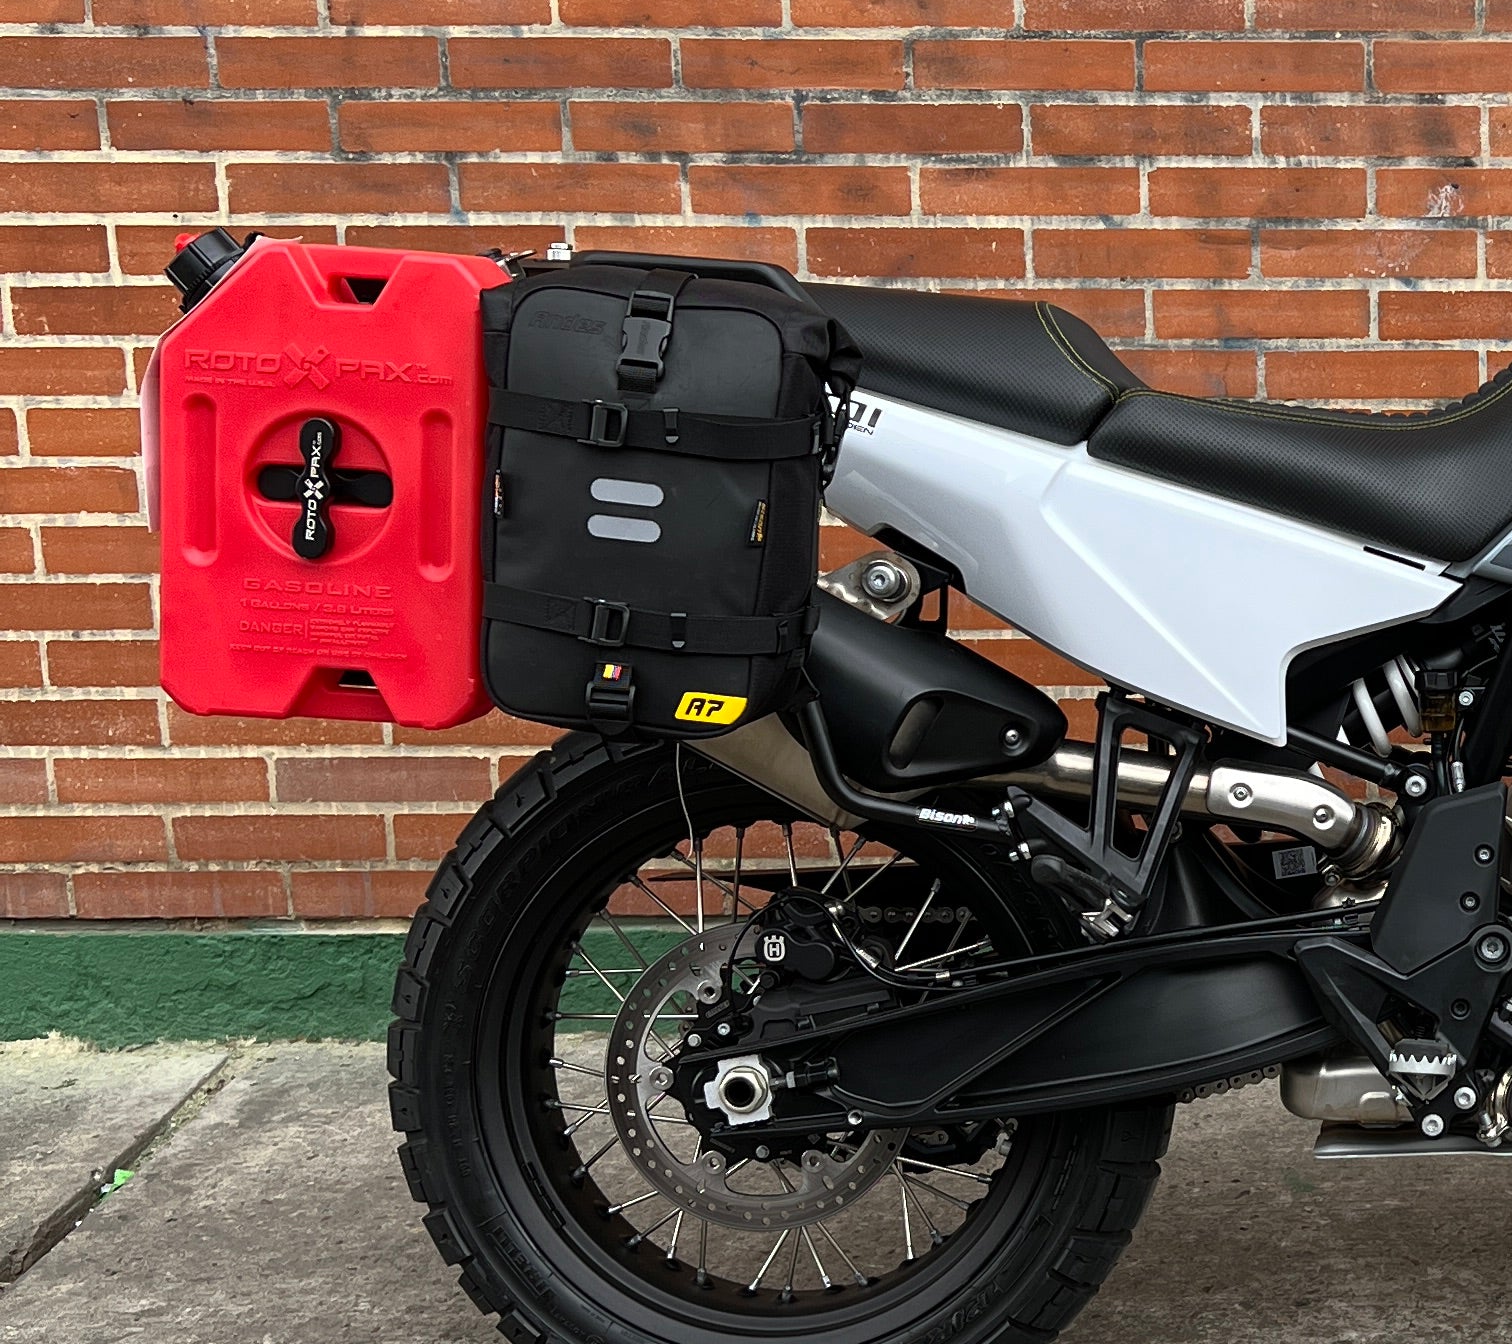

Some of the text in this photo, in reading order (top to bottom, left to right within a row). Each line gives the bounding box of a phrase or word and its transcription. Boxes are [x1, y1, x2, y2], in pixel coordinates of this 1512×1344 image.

[184, 347, 281, 373] ROTO
[304, 499, 318, 542] ROTO
[243, 577, 393, 599] GASOLINE
[239, 619, 304, 636] DANGER
